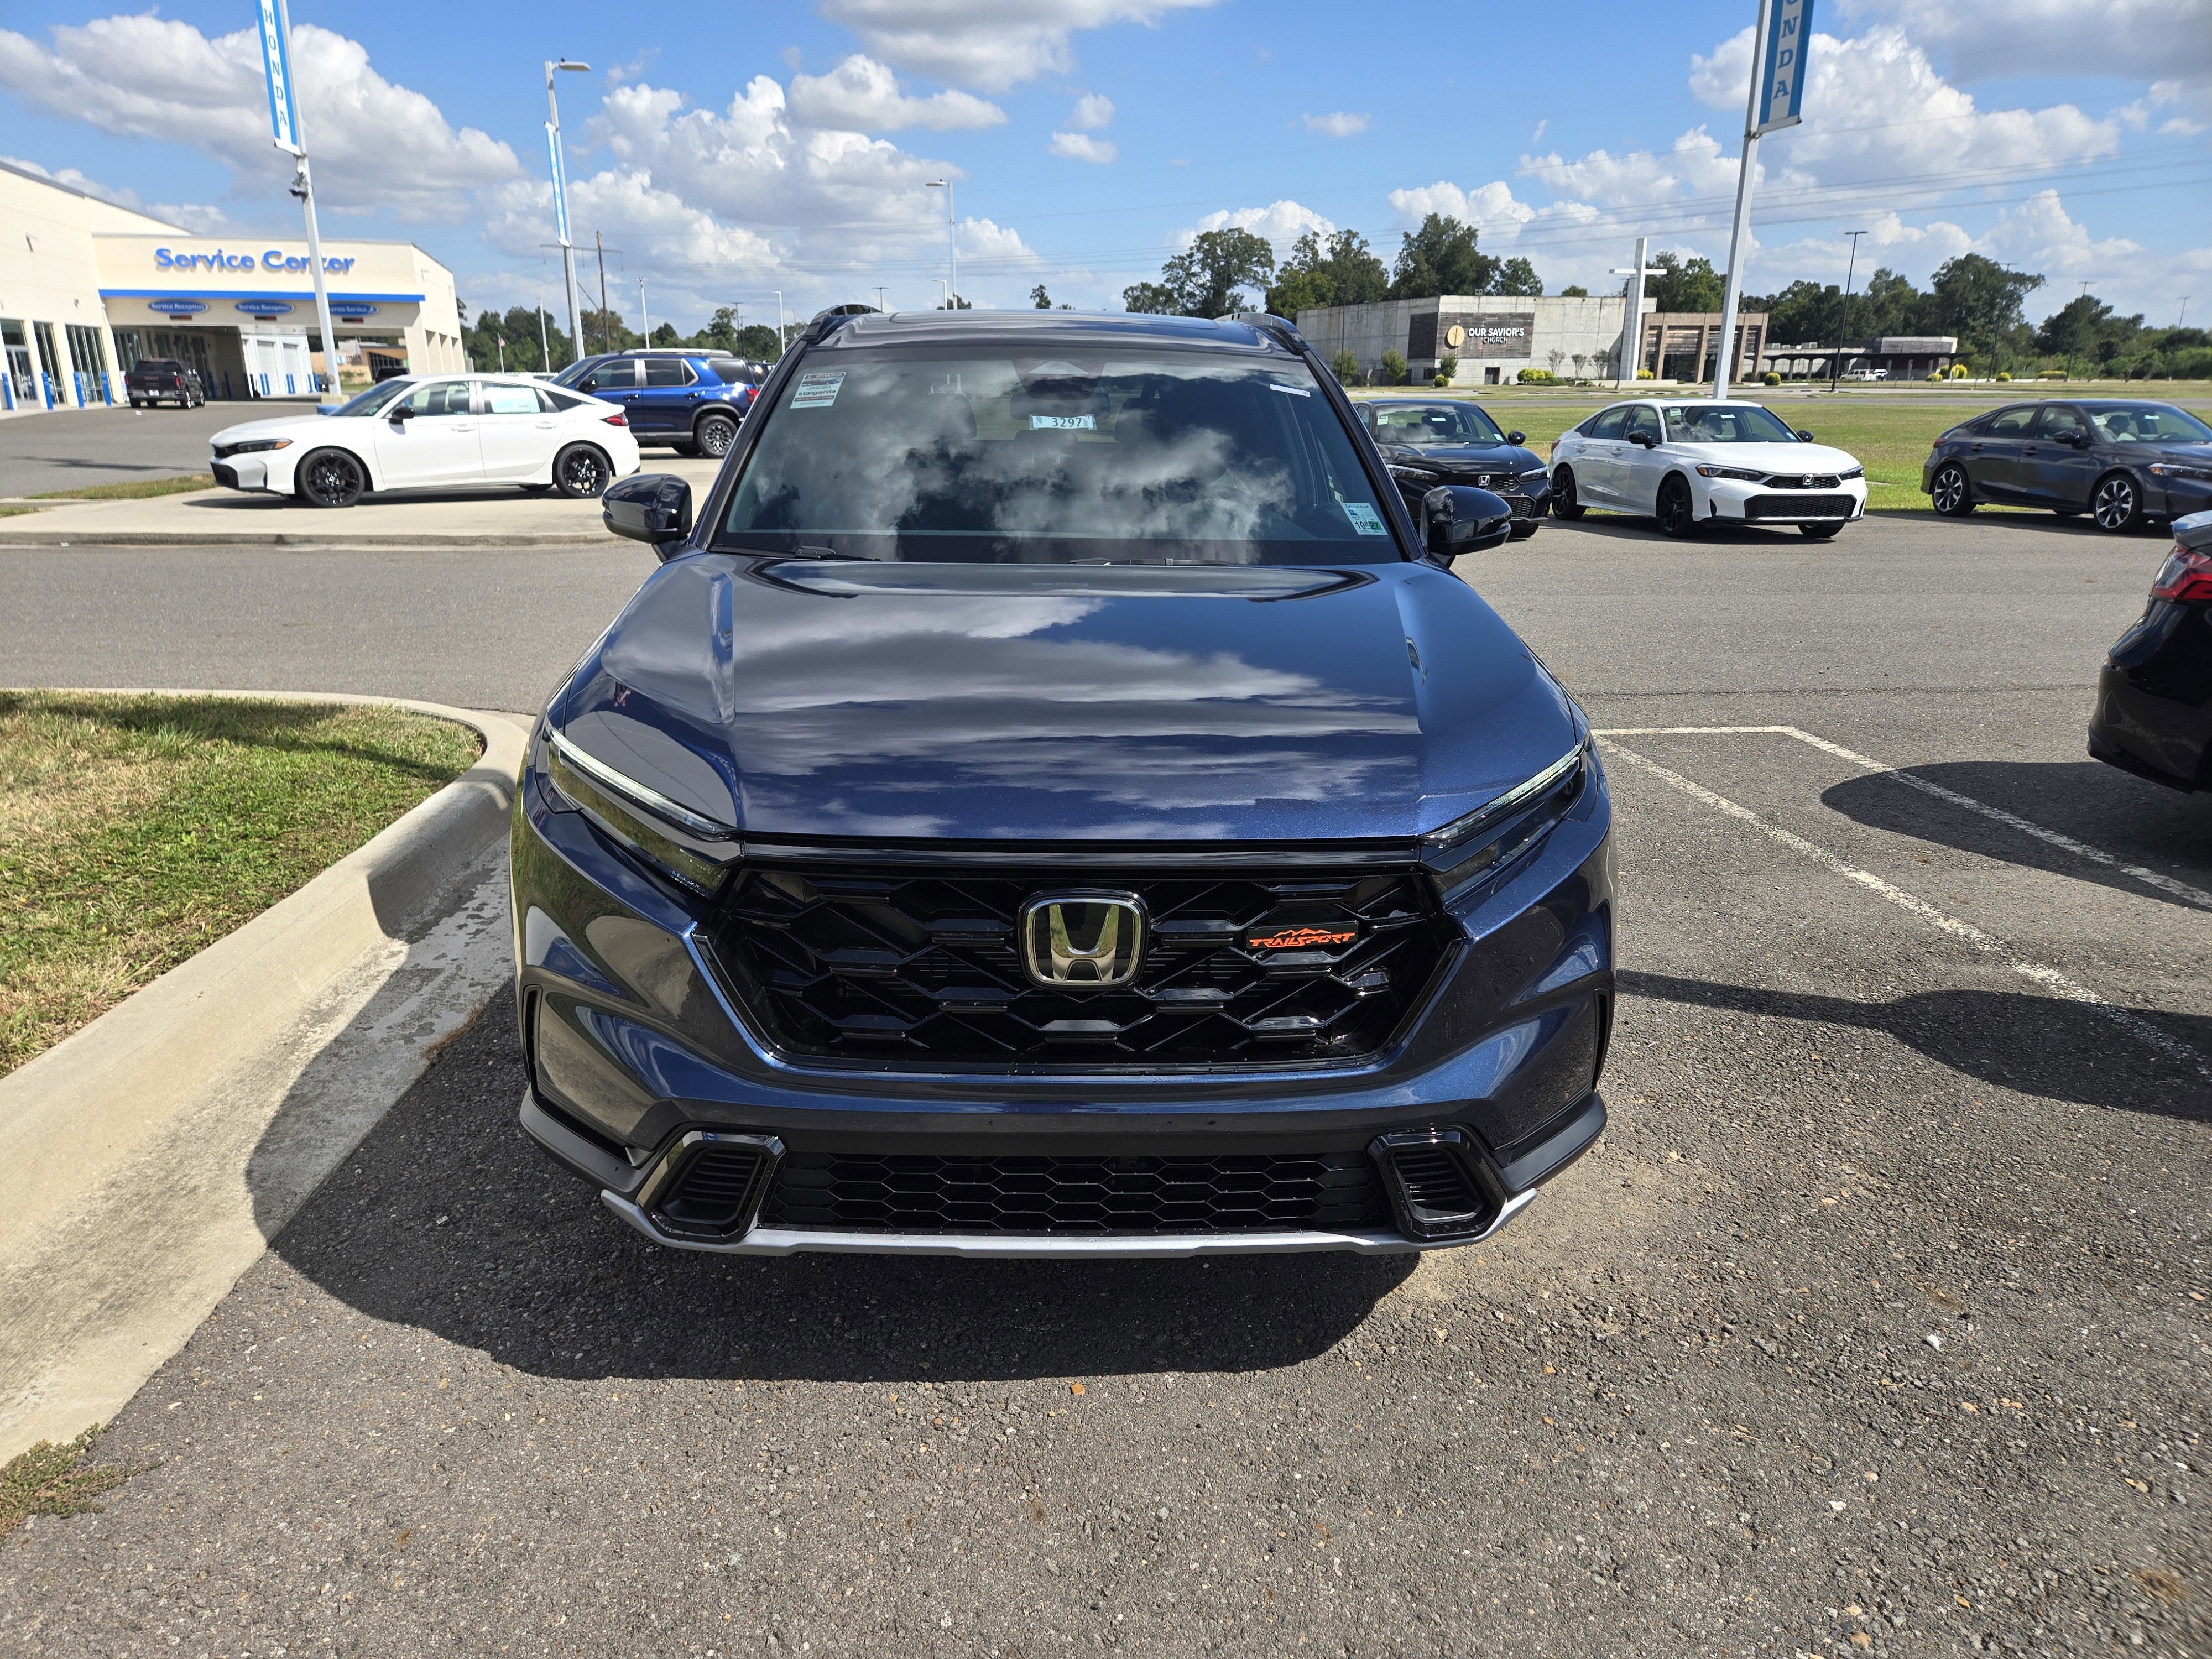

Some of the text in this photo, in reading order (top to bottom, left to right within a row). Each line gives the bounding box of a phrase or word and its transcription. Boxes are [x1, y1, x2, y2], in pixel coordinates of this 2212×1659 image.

[1773, 0, 1799, 99] NDA
[264, 8, 287, 126] HONDA
[154, 248, 255, 269] Service
[1468, 327, 1525, 337] OUR SAVIOR'S
[1052, 417, 1082, 427] 3297
[1355, 521, 1366, 529] 10
[1369, 521, 1379, 530] 27
[1249, 932, 1355, 948] TRAILSPORT
